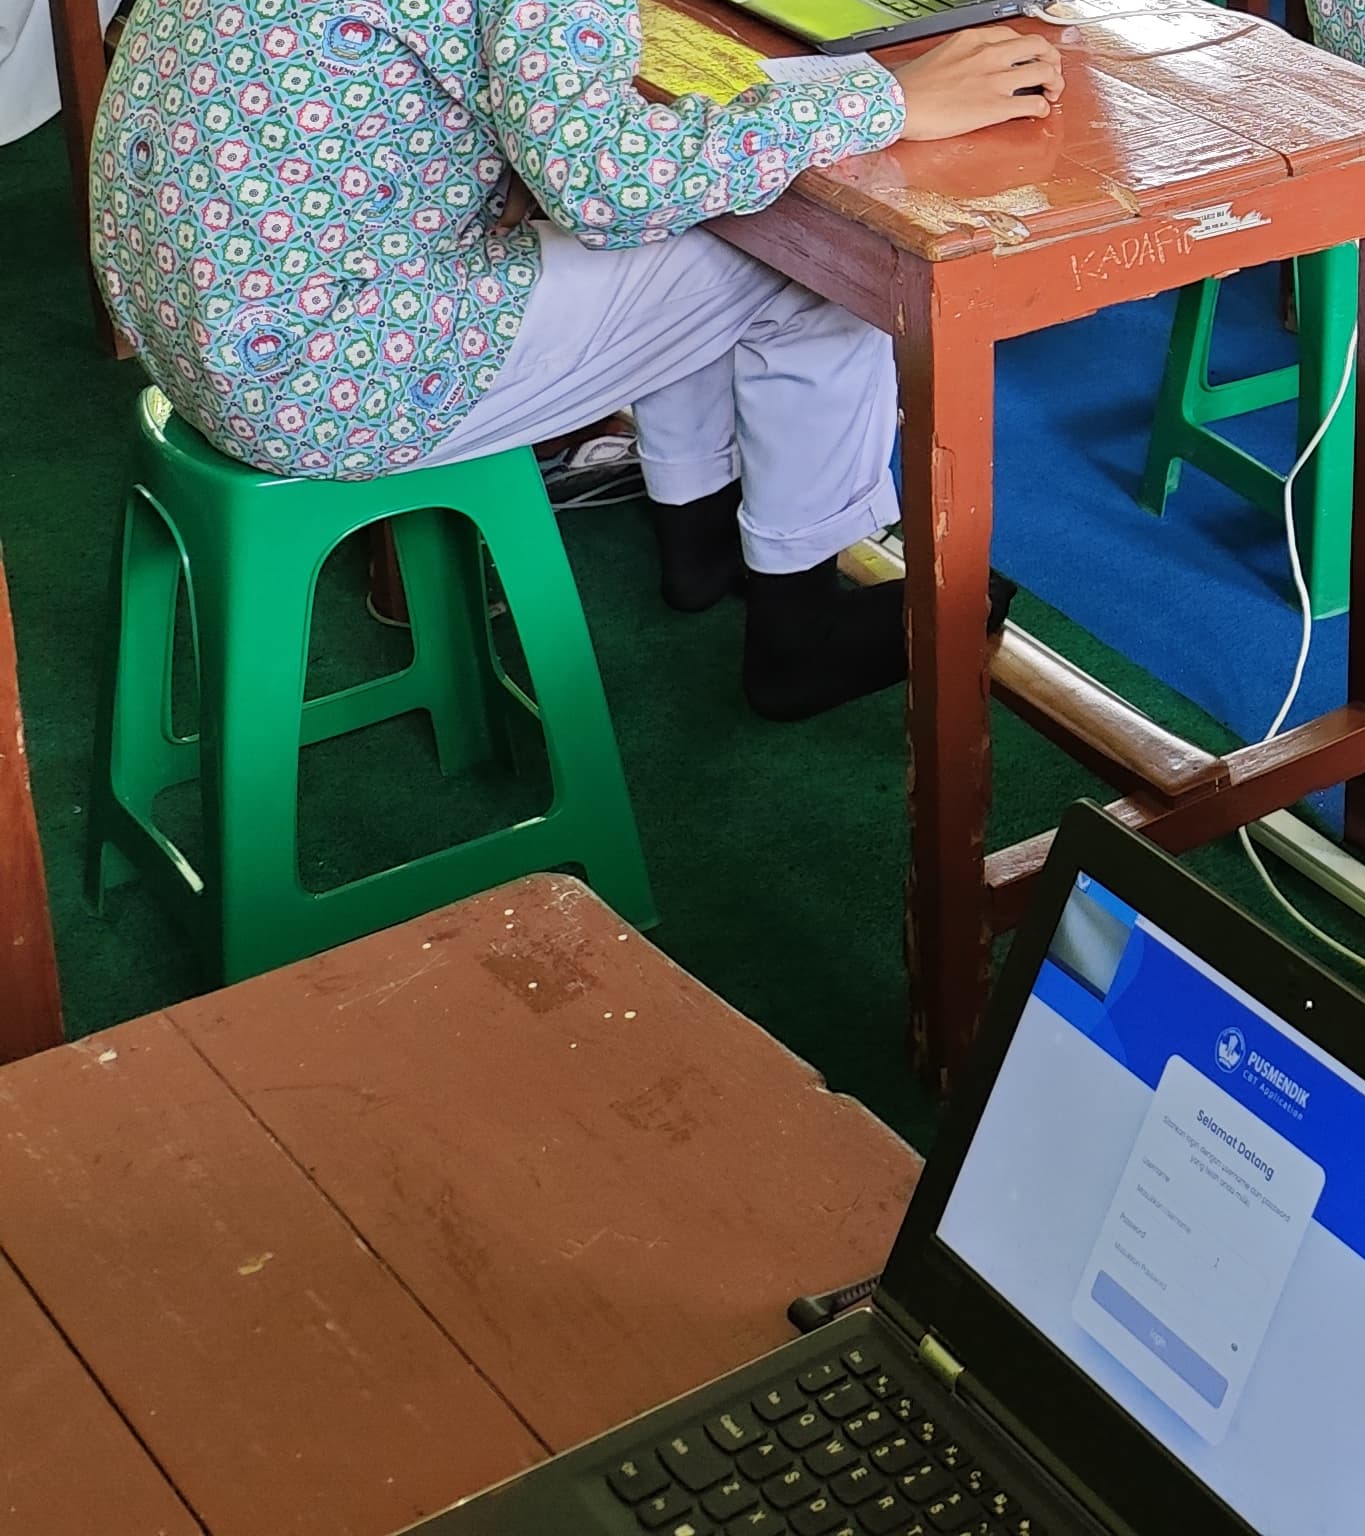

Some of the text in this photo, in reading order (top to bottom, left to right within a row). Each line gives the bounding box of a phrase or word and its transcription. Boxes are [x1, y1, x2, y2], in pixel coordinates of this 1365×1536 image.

[1242, 1069, 1304, 1121] CBT Application
[1247, 1051, 1310, 1109] PUSMENDIK
[1196, 1109, 1274, 1182] Selamat Datang
